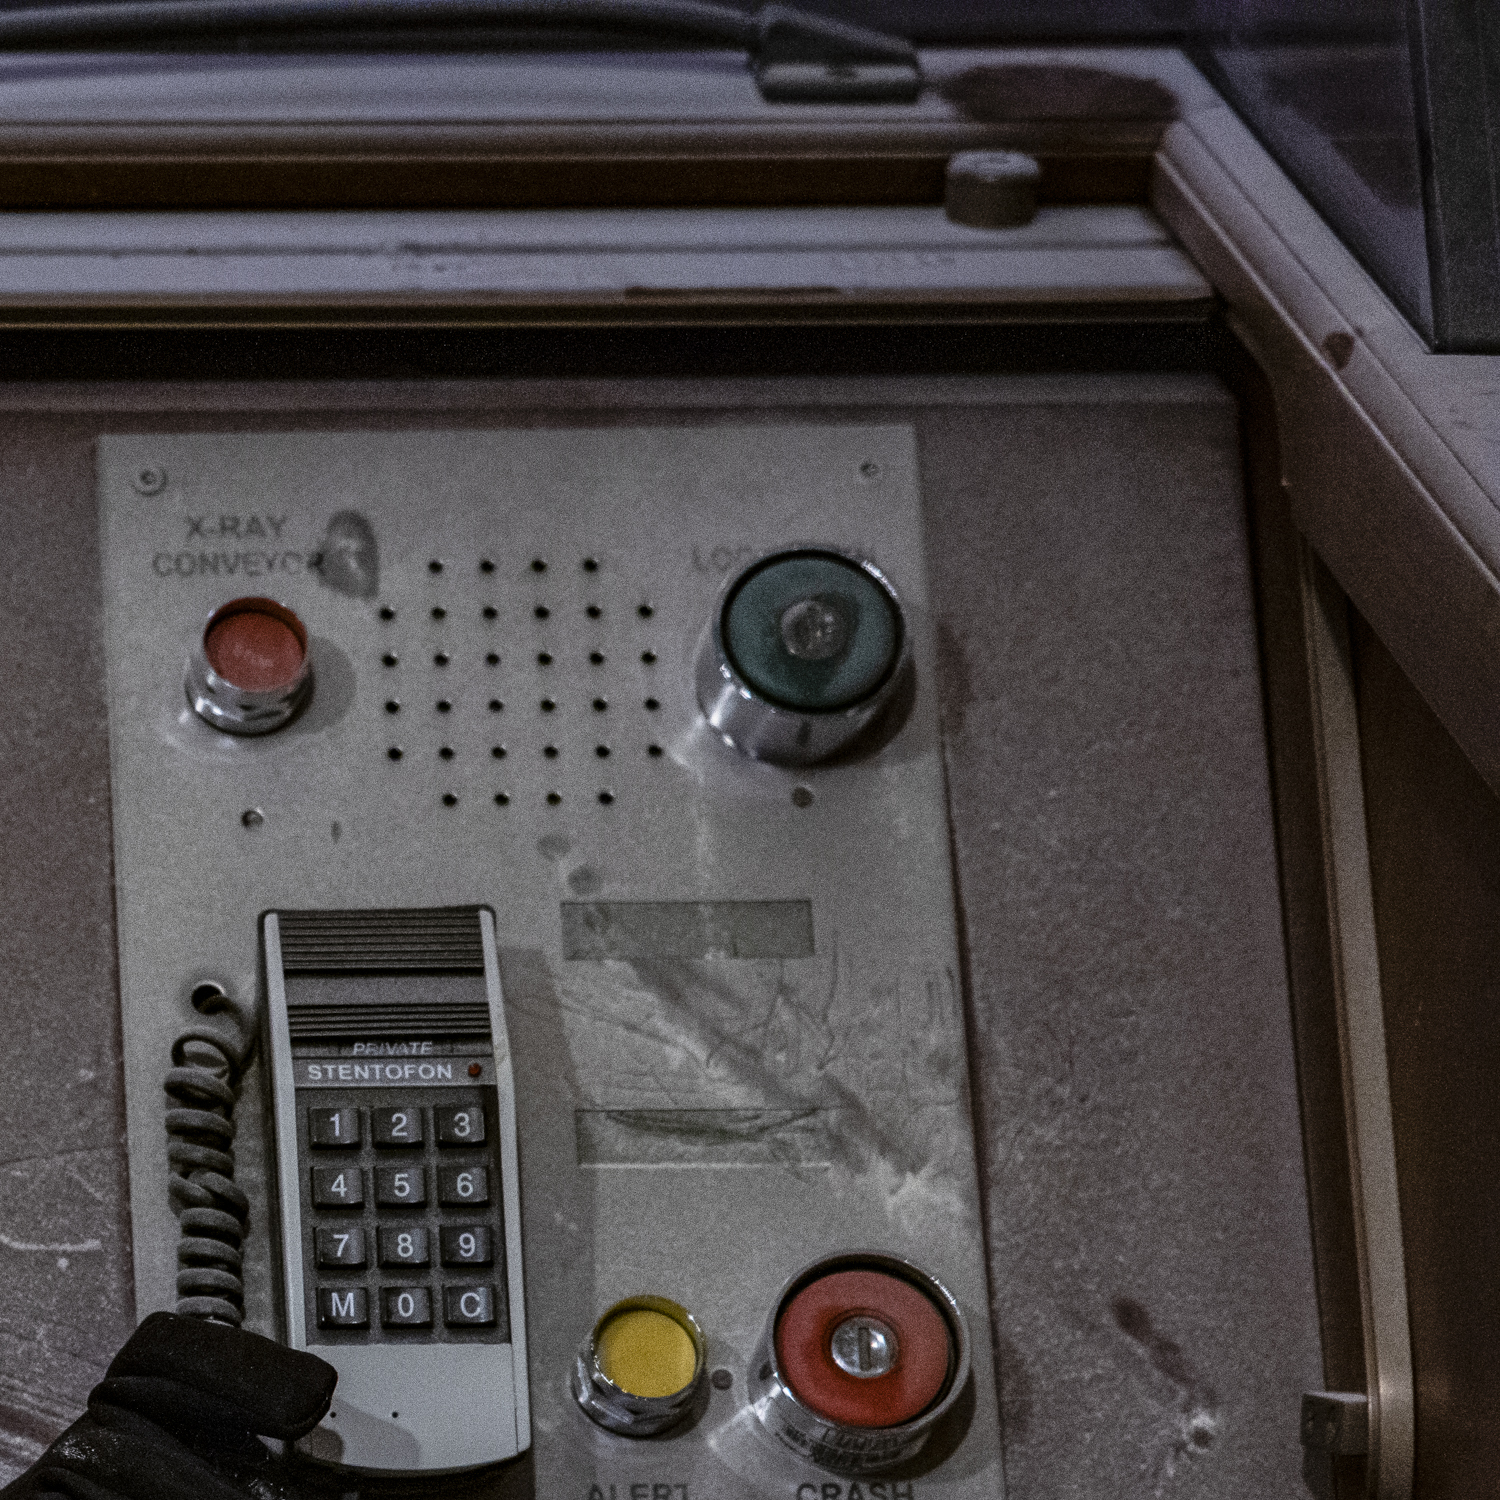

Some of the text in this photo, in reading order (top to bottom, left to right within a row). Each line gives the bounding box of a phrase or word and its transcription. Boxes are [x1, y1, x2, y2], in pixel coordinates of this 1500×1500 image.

[186, 514, 289, 542] X-RAY
[152, 550, 320, 580] CONVEYO
[353, 1041, 433, 1056] PRIVATE
[307, 1064, 453, 1081] STENTOFON
[329, 1112, 471, 1137] 1 2 3
[331, 1172, 474, 1198] 4 5 6
[333, 1232, 476, 1258] 7 8 9
[331, 1292, 482, 1318] M 0 C
